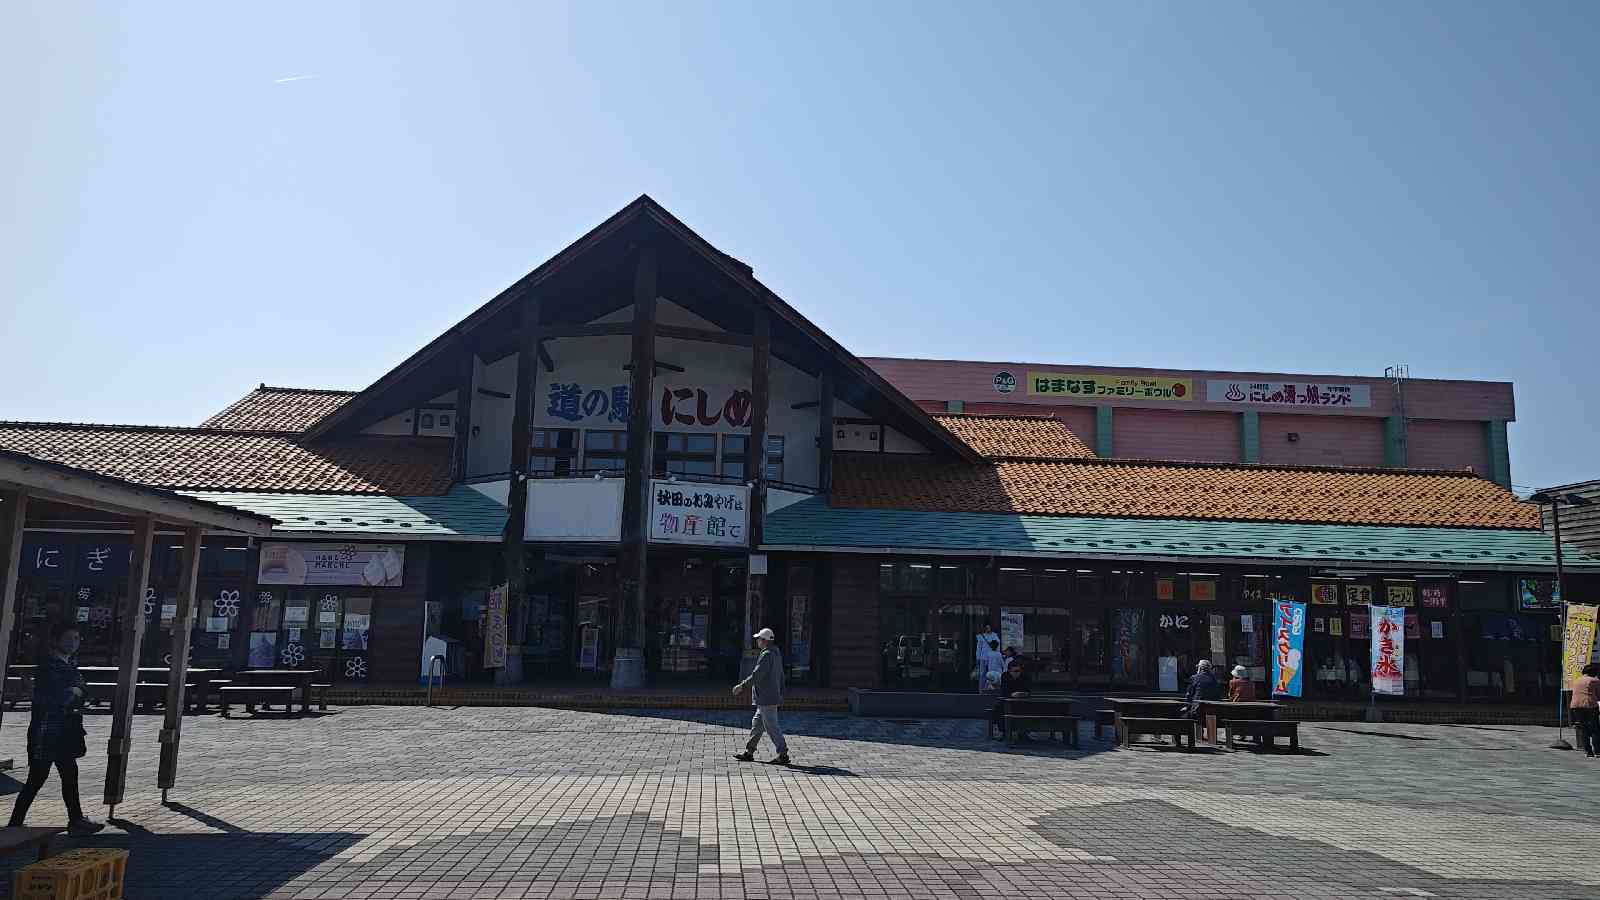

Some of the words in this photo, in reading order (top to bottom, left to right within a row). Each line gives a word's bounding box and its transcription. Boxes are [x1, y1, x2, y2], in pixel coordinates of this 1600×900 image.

[661, 388, 752, 427] にしめ
[659, 513, 741, 538] 物産館で
[1159, 613, 1190, 629] かに
[1375, 617, 1400, 673] かき氷
